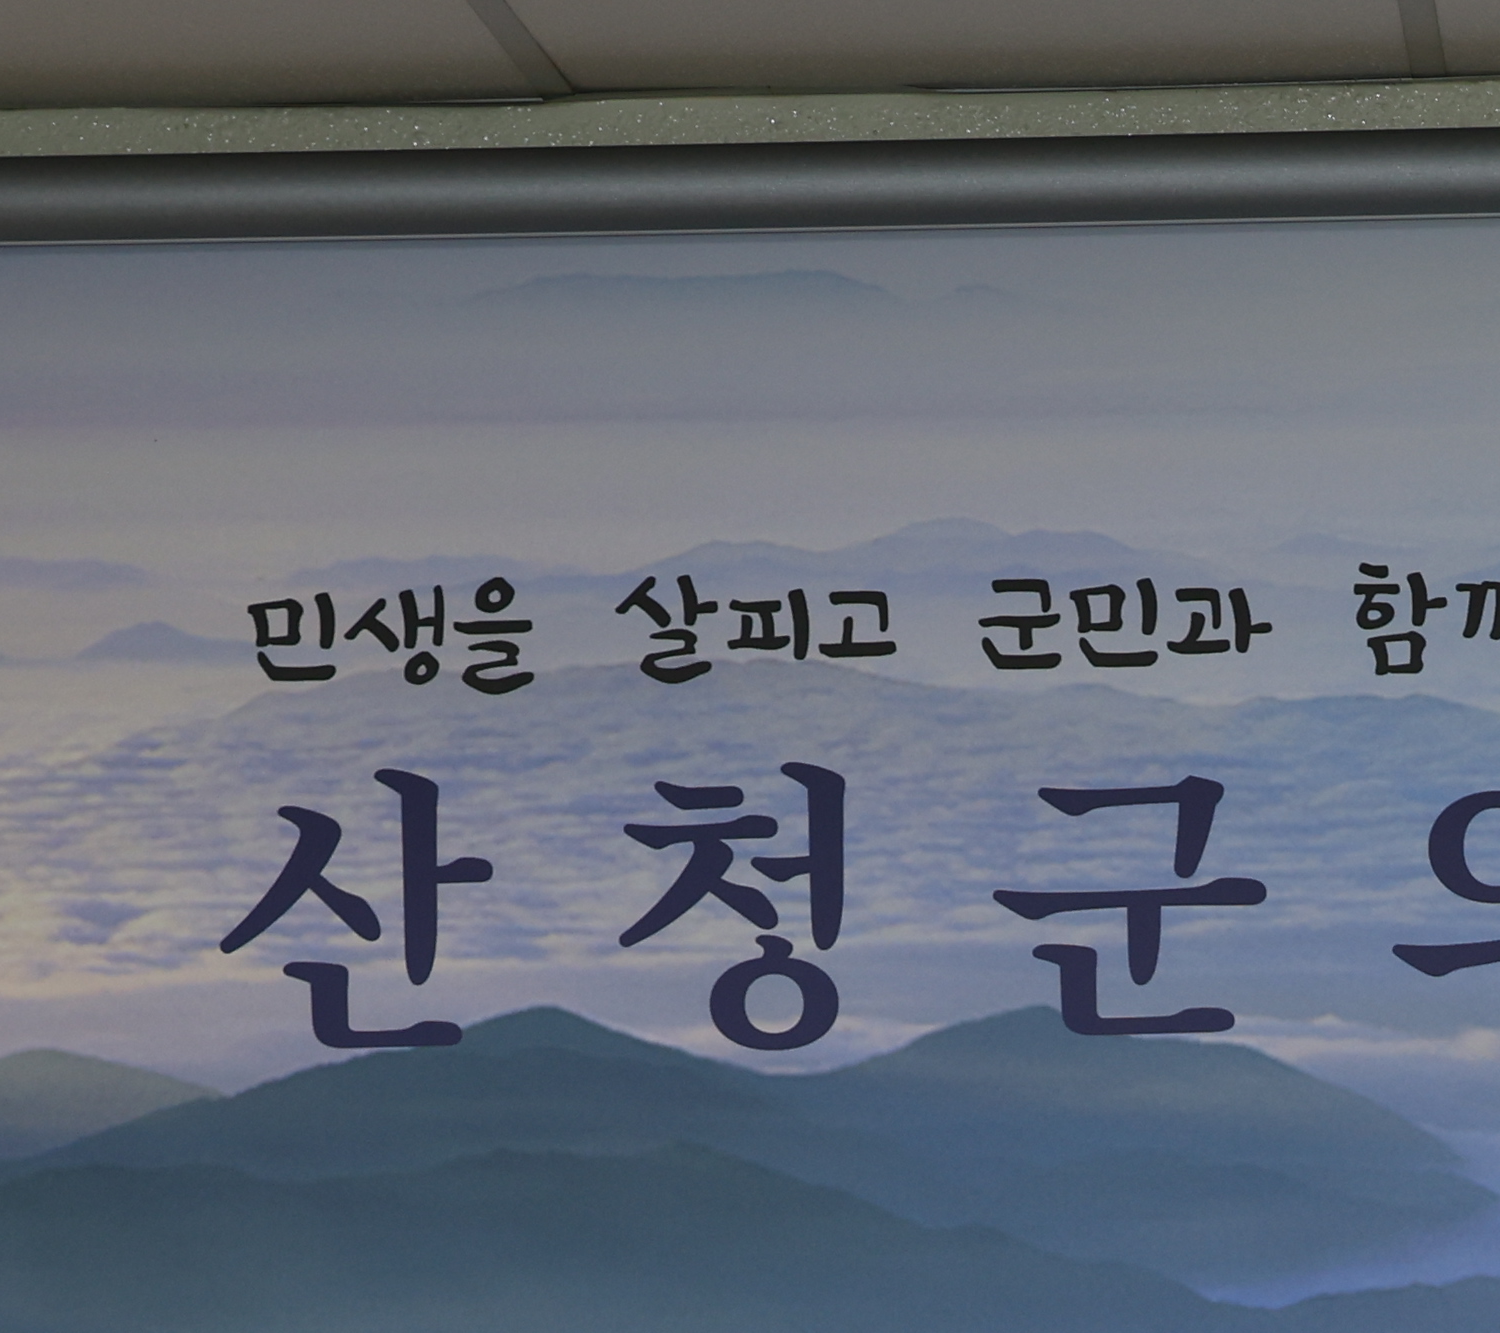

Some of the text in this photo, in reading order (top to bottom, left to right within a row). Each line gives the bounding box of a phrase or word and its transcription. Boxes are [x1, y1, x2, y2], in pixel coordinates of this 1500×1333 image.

[246, 576, 535, 696] 민생을
[615, 574, 897, 684] 살피고
[978, 577, 1273, 670] 군민과
